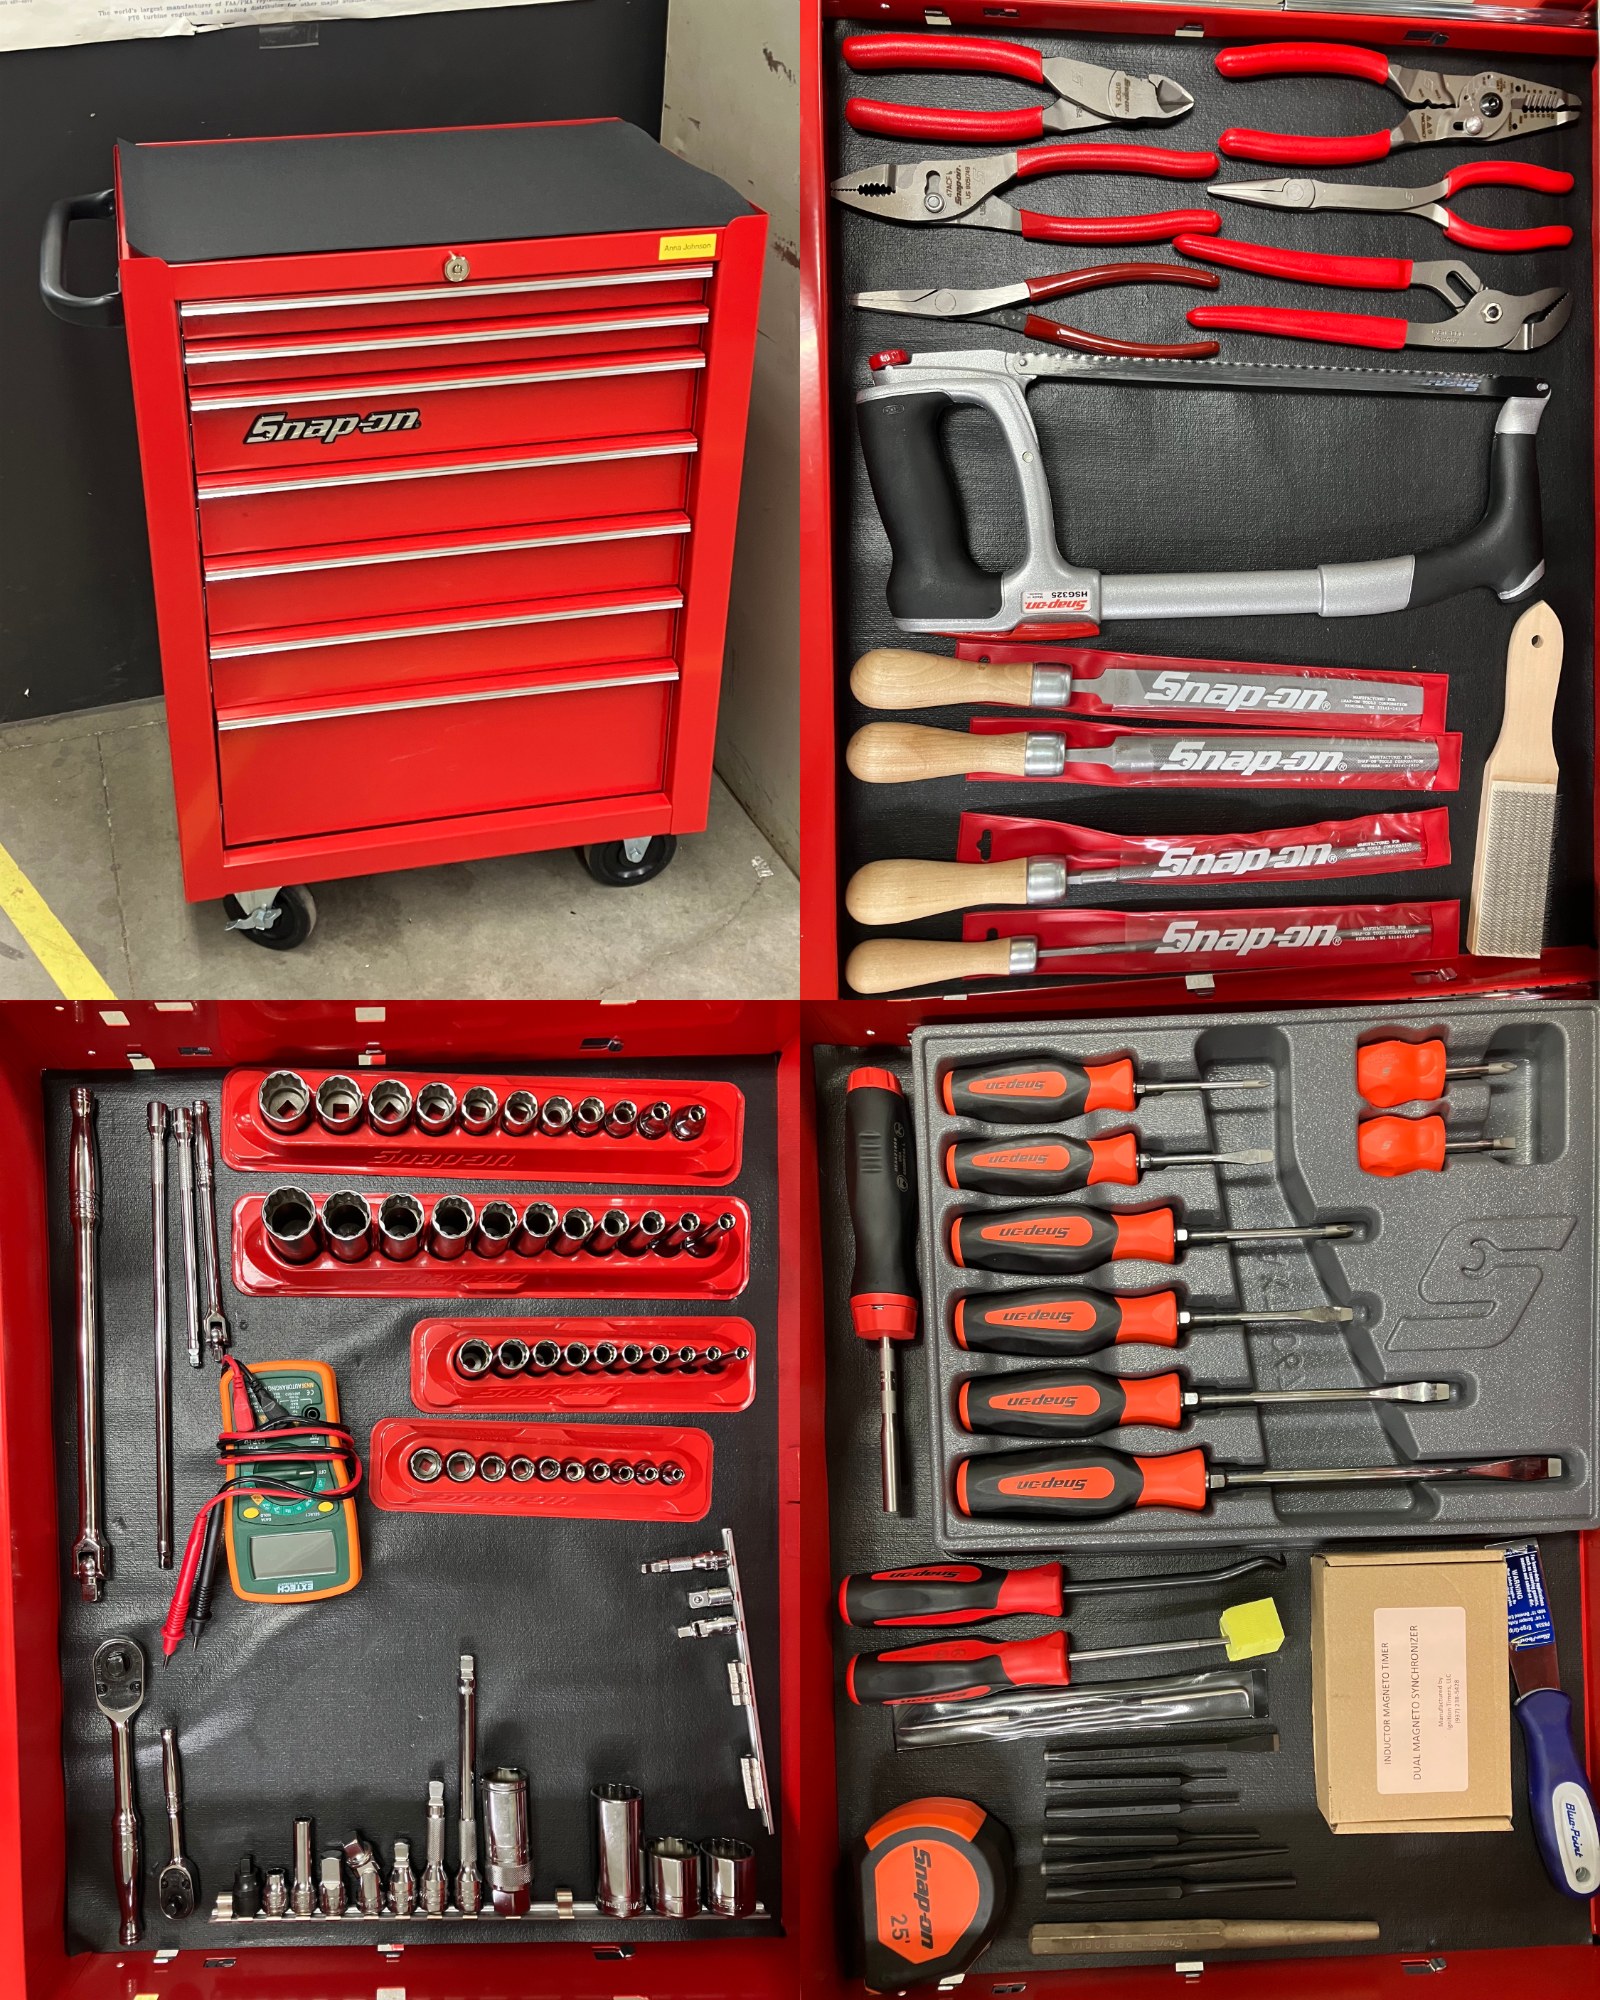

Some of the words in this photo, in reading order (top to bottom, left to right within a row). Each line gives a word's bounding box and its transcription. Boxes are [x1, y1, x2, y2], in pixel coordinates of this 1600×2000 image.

[955, 166, 963, 206] Snap-on
[244, 410, 421, 444] Snap-on
[1052, 590, 1088, 598] HSG325
[1024, 598, 1088, 610] Snap-on
[986, 1079, 1045, 1090] Snap-on
[367, 1150, 516, 1169] Snap-on
[988, 1152, 1048, 1164] Snap-on
[999, 1224, 1070, 1238] Snap-on
[1003, 1310, 1074, 1323] Snap-on
[268, 1383, 302, 1391] AUTORANGING
[1007, 1394, 1078, 1408] Snap-on
[1016, 1477, 1088, 1490] Snap-on
[889, 1570, 960, 1579] Snap-on
[277, 1584, 314, 1593] EXTECH
[1512, 1569, 1524, 1600] WARNING
[1508, 1624, 1532, 1634] Ergo-Grip
[1381, 1642, 1389, 1670] TIMER
[1410, 1625, 1420, 1698] SYNCHRONIZER
[1438, 1677, 1444, 1685] by
[1382, 1672, 1390, 1716] MAGNETO
[1412, 1702, 1420, 1752] MAGNETO
[1384, 1719, 1392, 1765] INDUCTOR
[1413, 1754, 1422, 1780] DUAL
[1566, 1803, 1584, 1858] Blue-Point
[913, 1846, 934, 1950] Snap-on
